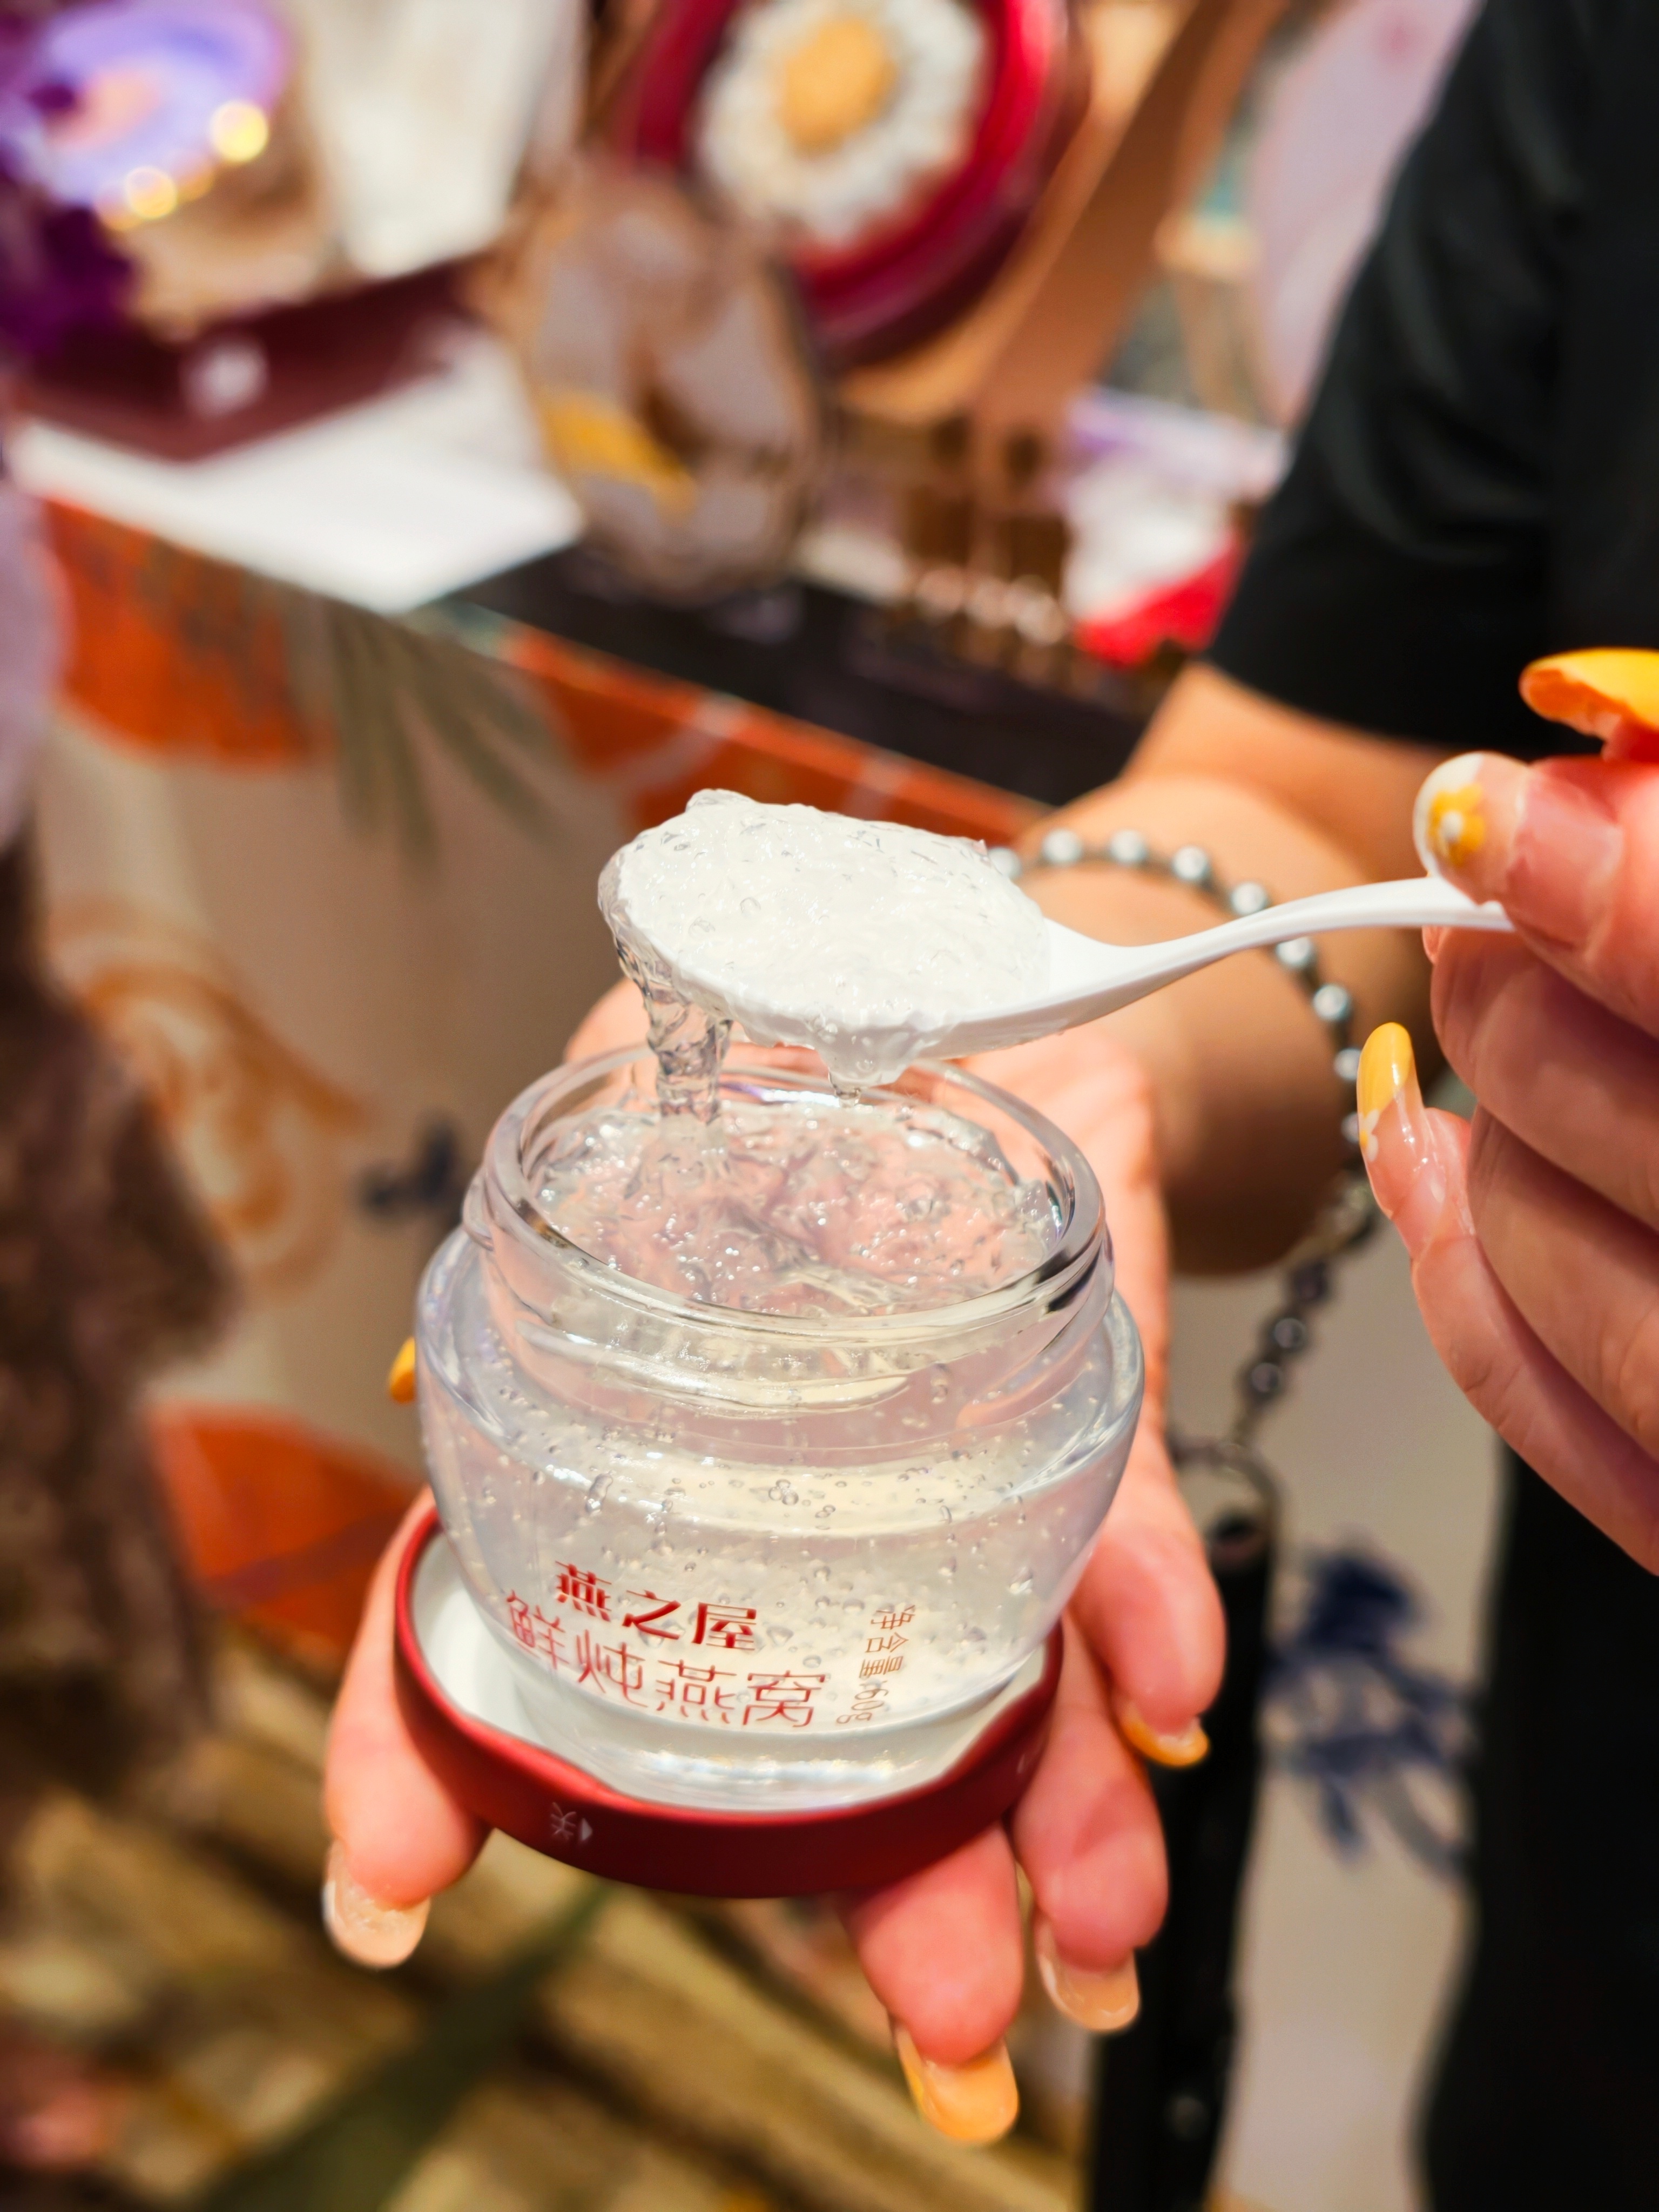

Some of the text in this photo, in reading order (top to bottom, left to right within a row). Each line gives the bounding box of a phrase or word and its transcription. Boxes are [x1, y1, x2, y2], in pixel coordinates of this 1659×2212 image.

[506, 1590, 826, 1728] 鲜炖燕窝
[555, 1561, 757, 1651] 燕之屋
